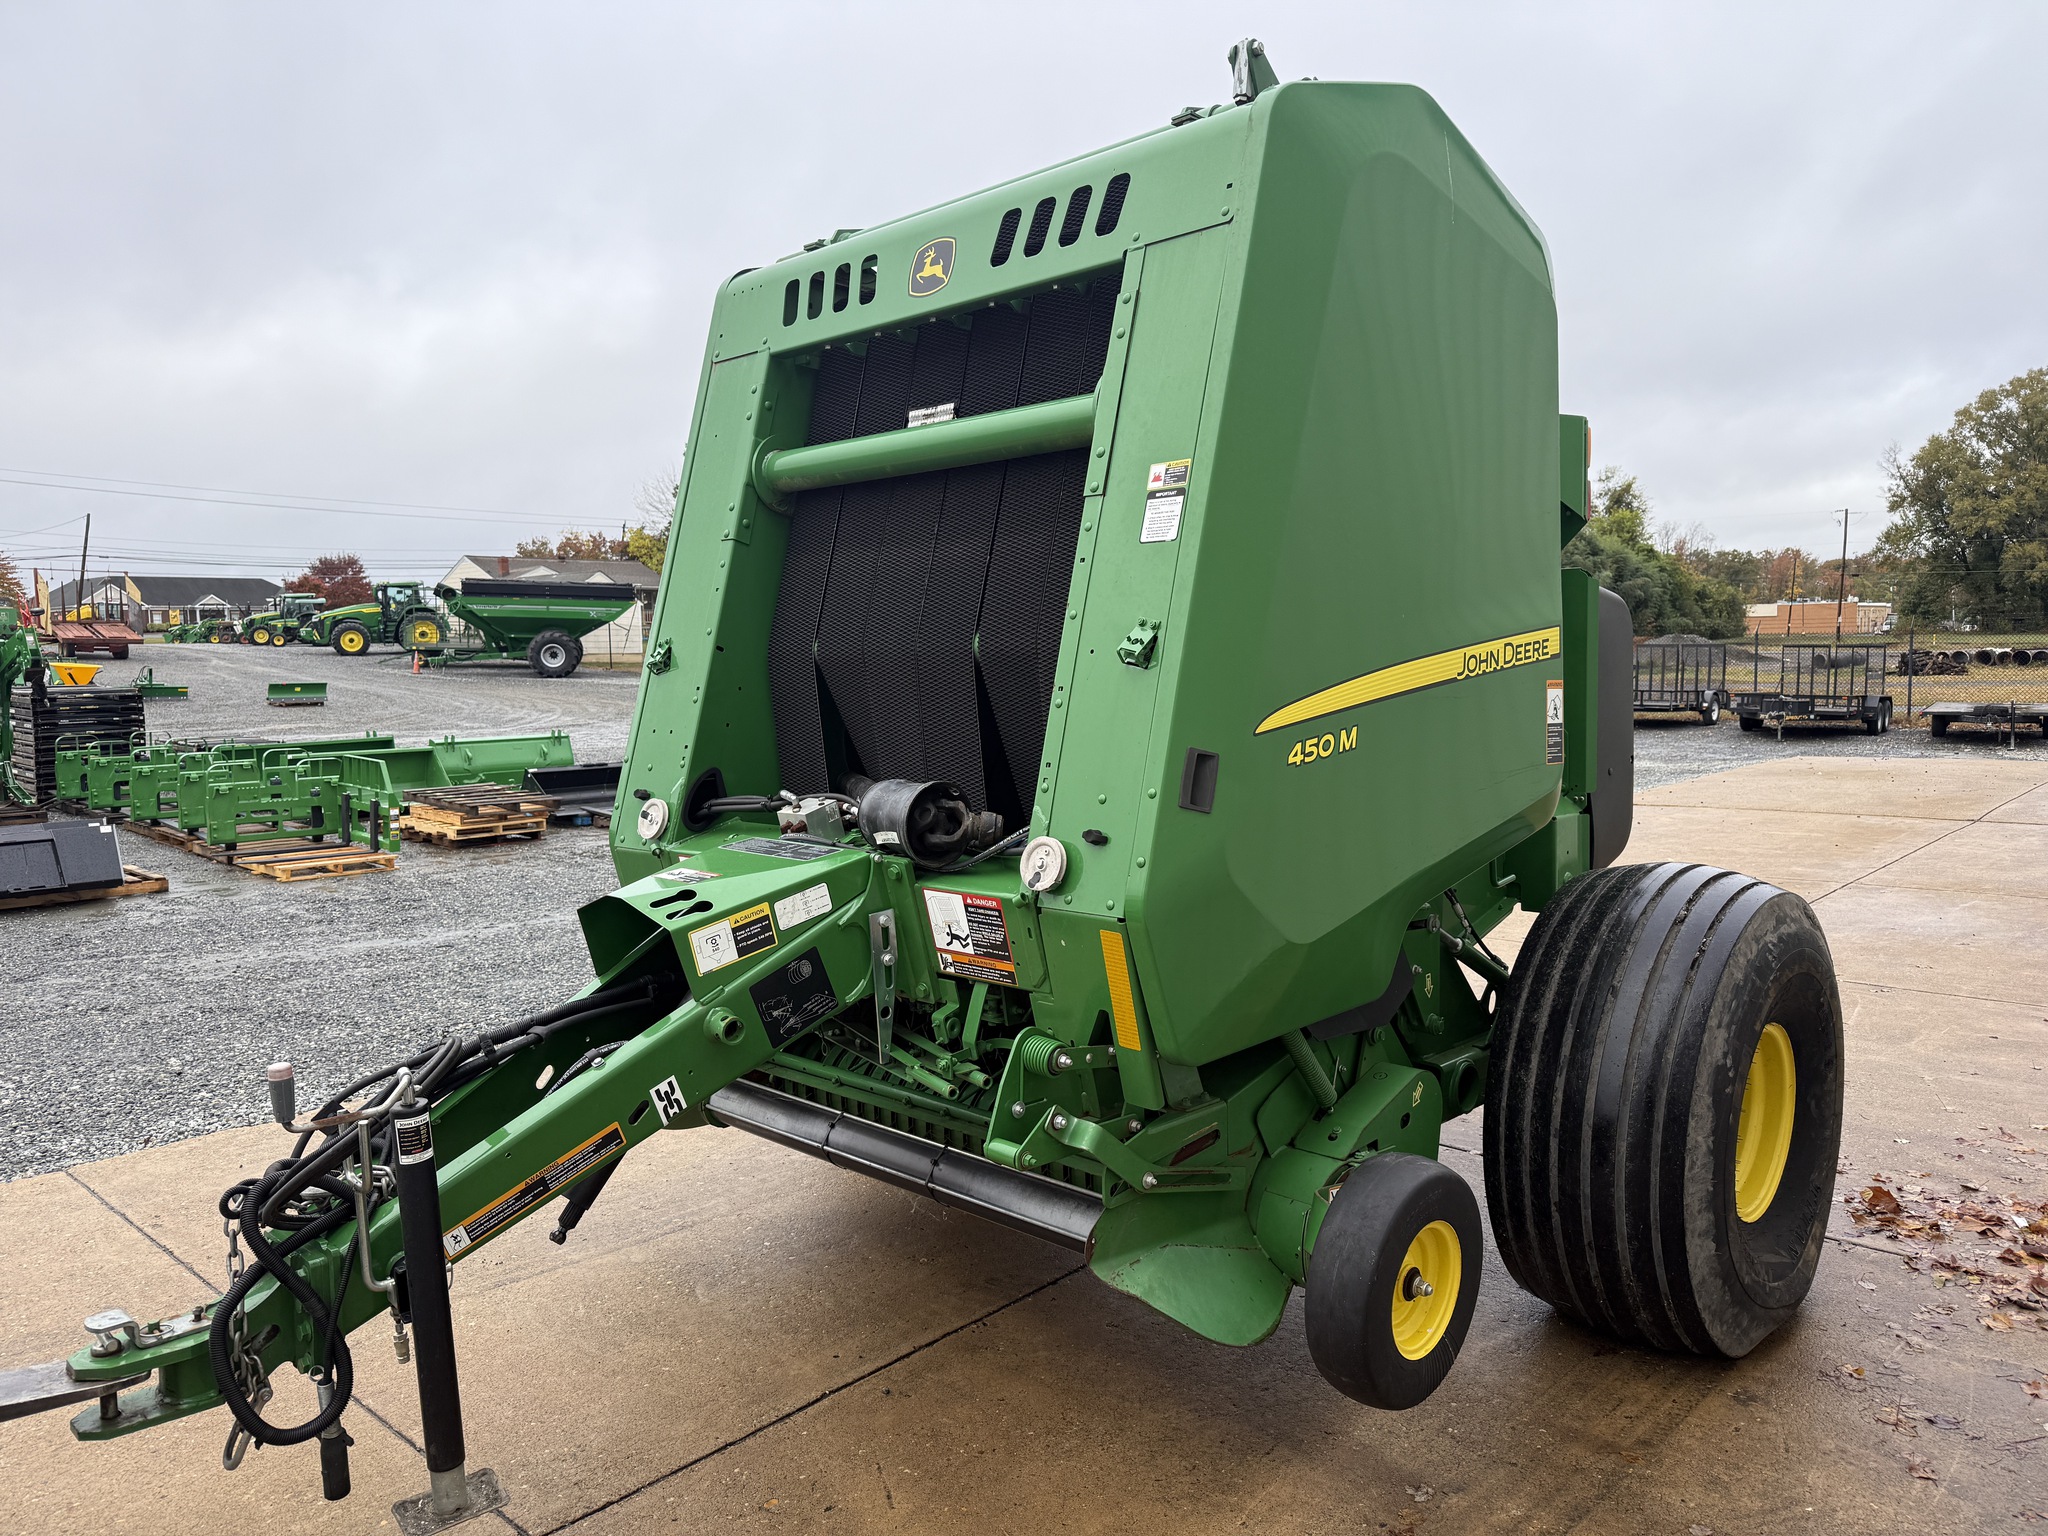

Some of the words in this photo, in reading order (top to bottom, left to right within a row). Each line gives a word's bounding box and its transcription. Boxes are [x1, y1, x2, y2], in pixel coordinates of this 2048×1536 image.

[1457, 648, 1501, 678] JOHN
[1503, 638, 1550, 666] DEERE
[1287, 733, 1335, 766] 450
[1338, 725, 1359, 753] M
[972, 898, 998, 908] DANGER
[740, 908, 765, 921] CAUTION
[972, 959, 997, 968] WARNING
[528, 1161, 560, 1184] WARNING
